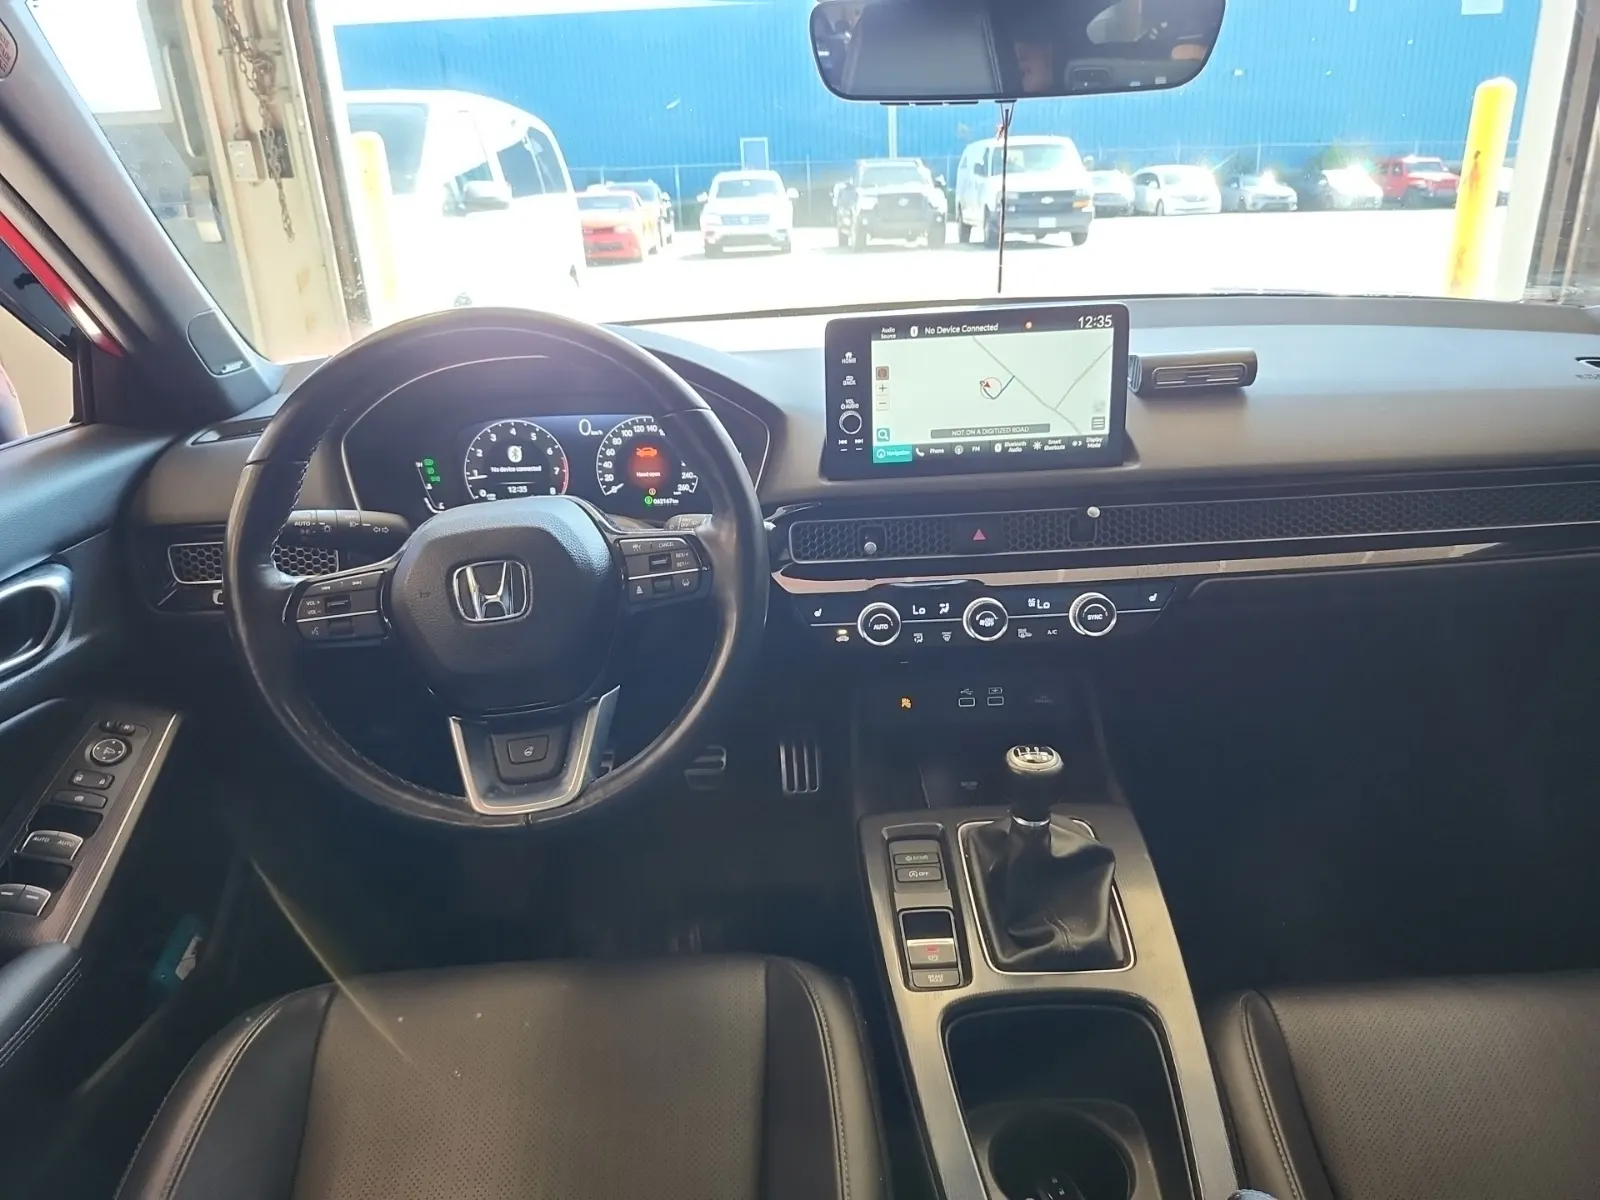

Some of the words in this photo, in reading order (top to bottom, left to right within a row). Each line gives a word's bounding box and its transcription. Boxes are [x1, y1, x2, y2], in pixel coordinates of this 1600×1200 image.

[1077, 314, 1113, 329] 12:35
[881, 326, 896, 334] Audio
[924, 326, 936, 335] No
[936, 325, 961, 335] Device
[961, 322, 999, 334] Connected
[509, 427, 517, 436] 4
[578, 418, 592, 436] 0
[633, 424, 645, 433] 120
[646, 424, 658, 433] 140
[982, 427, 1011, 435] DIGITIZED
[1011, 426, 1029, 434] ROAD
[489, 433, 497, 442] 3
[530, 432, 538, 441] 5
[621, 429, 633, 437] 100
[612, 437, 622, 445] 80
[476, 448, 483, 457] 2
[546, 447, 554, 456] 6
[605, 448, 616, 456] 60
[602, 461, 613, 469] 40
[553, 467, 560, 475] 7
[681, 471, 694, 479] 240
[604, 473, 615, 481] 20
[507, 485, 528, 494] 12:35
[549, 486, 556, 495] 8
[677, 483, 690, 492] 260
[479, 488, 487, 498] 0
[1036, 599, 1051, 610] Lo
[912, 604, 926, 615] Lo
[1087, 613, 1104, 621] SYNC
[873, 623, 889, 631] AUTO
[57, 839, 75, 848] AUTO
